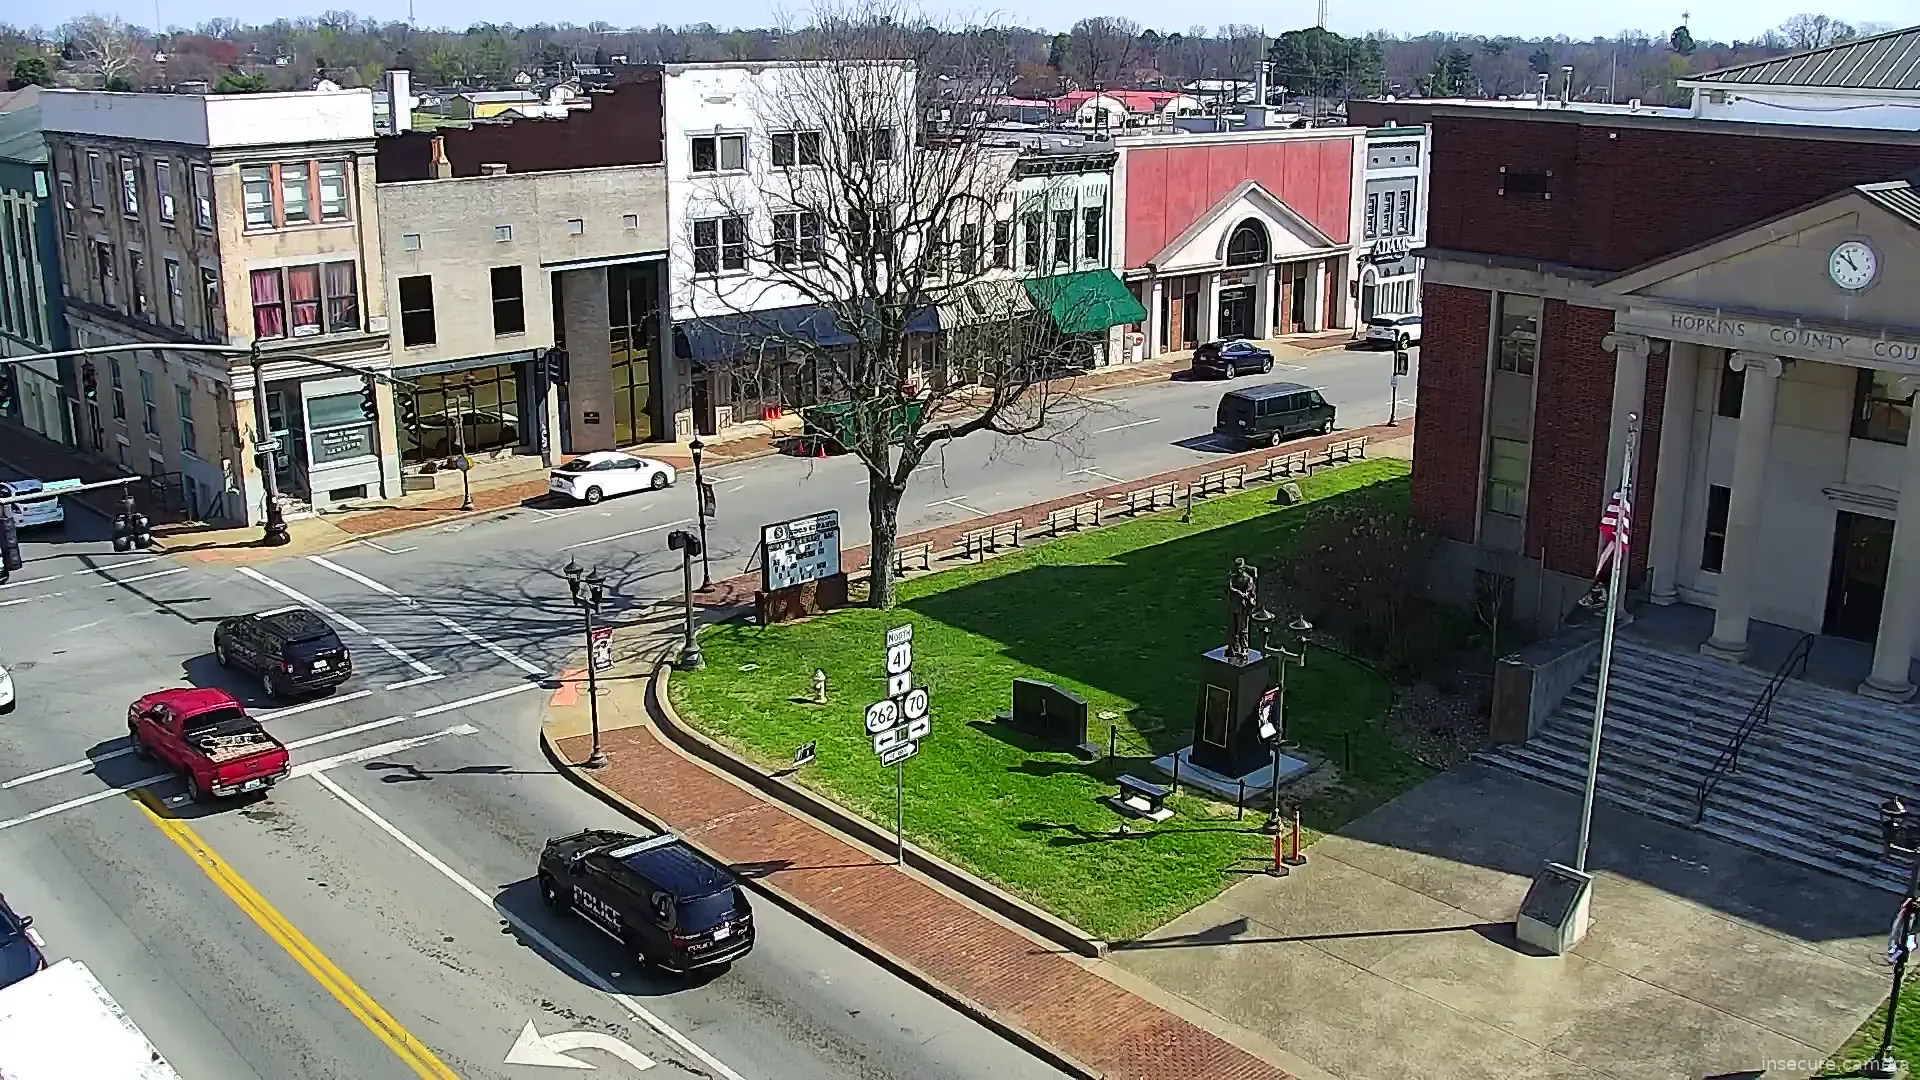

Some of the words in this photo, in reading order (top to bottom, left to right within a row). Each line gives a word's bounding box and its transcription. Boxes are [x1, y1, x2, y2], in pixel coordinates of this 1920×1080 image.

[1671, 314, 1745, 338] HOPKINS
[1770, 327, 1850, 350] COUNTY
[888, 629, 911, 643] NORTH
[892, 649, 907, 668] 41
[909, 694, 924, 713] 70
[870, 704, 894, 728] 262
[573, 884, 622, 927] POLICE
